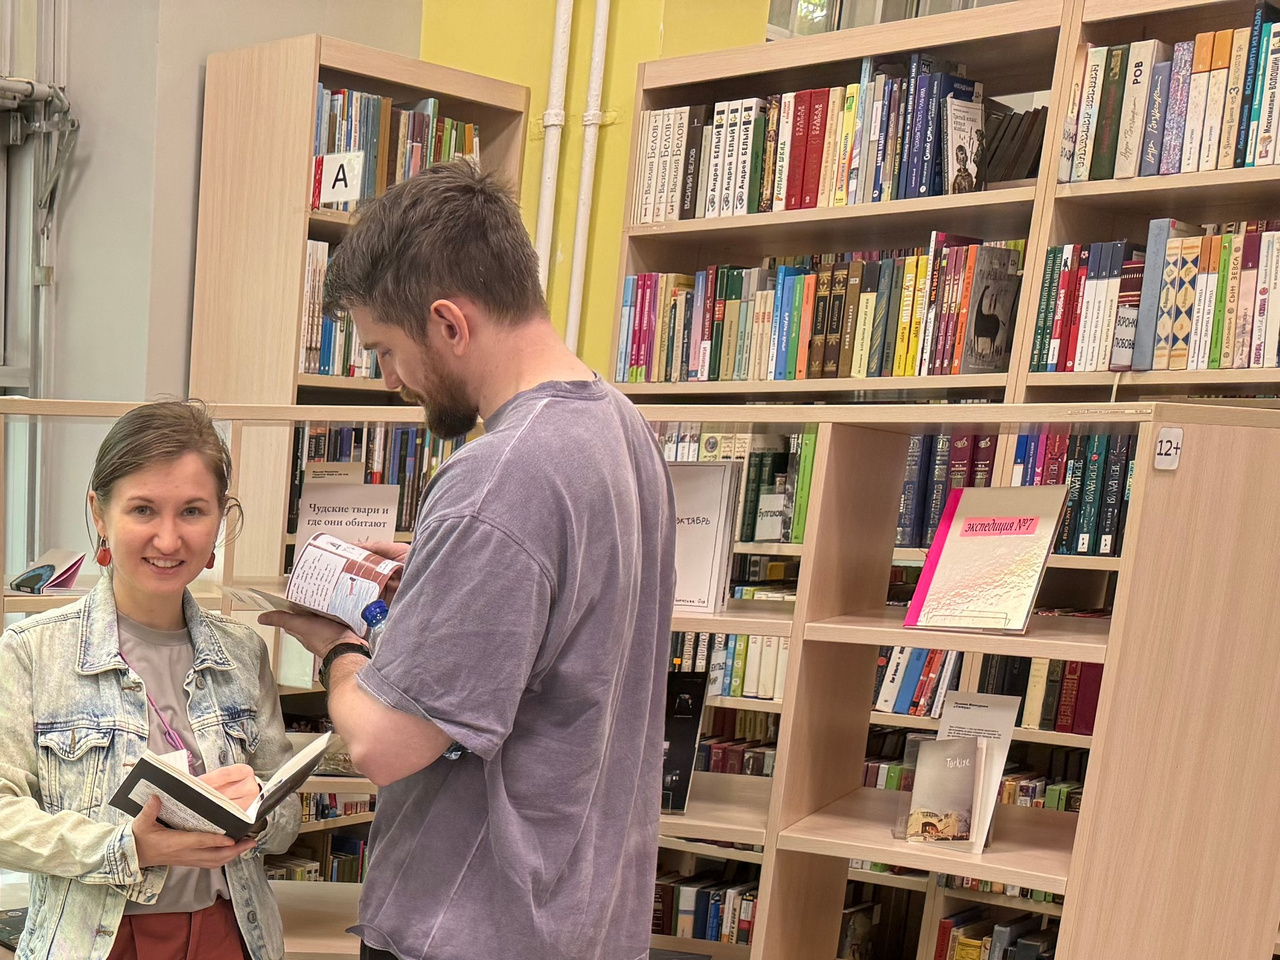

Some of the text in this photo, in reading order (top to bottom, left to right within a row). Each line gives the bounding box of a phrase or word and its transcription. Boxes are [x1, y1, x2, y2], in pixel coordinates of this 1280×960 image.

[1251, 35, 1259, 47] ИЗ
[1132, 59, 1144, 86] РОВ
[1247, 47, 1257, 75] ВЫЙТИ
[1244, 74, 1254, 95] ВСЕМ
[1263, 56, 1279, 135] Максимилиан ВОЛОШИН
[646, 124, 660, 160] Белов
[660, 122, 673, 159] Белов
[672, 120, 686, 158] Белов
[778, 139, 787, 164] ШКИД
[710, 129, 723, 193] Андрей БЕЛЫЙ
[724, 127, 737, 192] Андрей БЕЛЫЙ
[738, 125, 751, 190] Андрей БЕЛЫЙ
[332, 163, 348, 189] A
[683, 147, 697, 210] ВАСИЛИЙ БЕЛОВ
[1228, 255, 1240, 304] СЫН ЗЕВСА
[900, 273, 915, 323] КАДЕТСТВО
[699, 346, 708, 377] НОВИНКИ
[1156, 440, 1181, 456] 12+
[307, 519, 322, 527] где
[345, 518, 387, 528] обитают
[309, 503, 349, 515] Чудские
[351, 507, 379, 516] твари
[758, 508, 783, 521] Булгаков
[964, 516, 1035, 535] экспедиция №7
